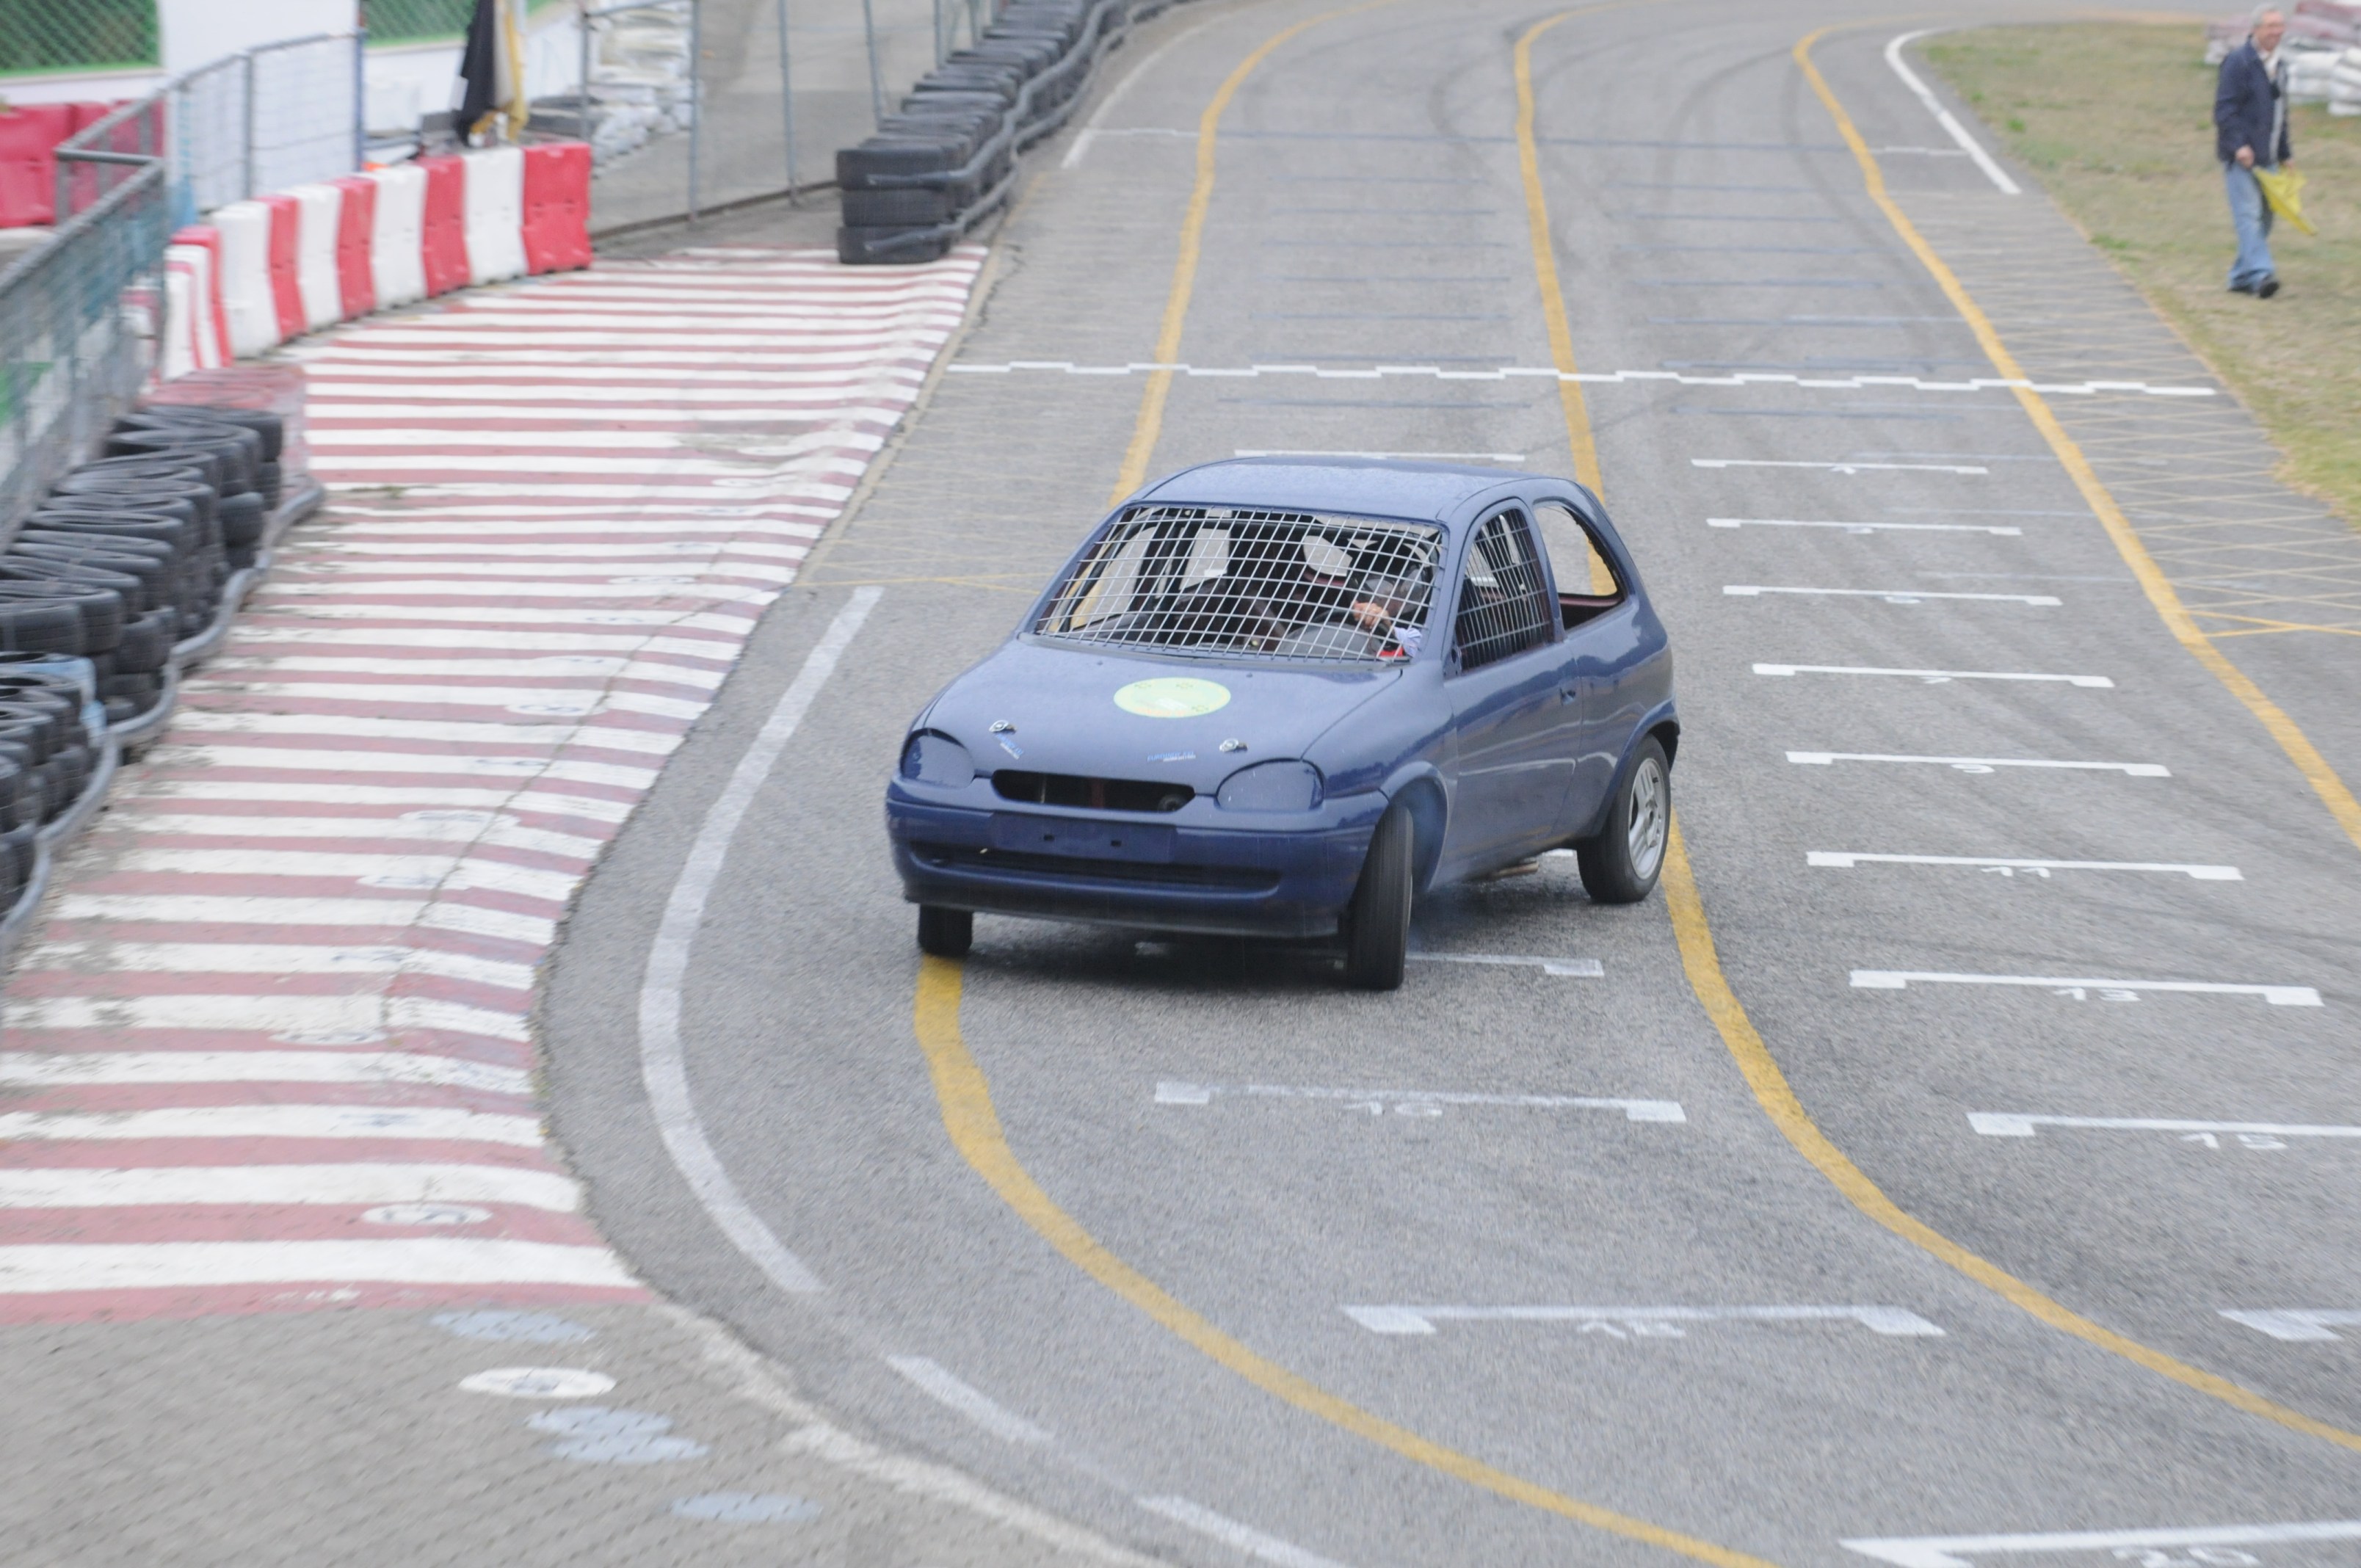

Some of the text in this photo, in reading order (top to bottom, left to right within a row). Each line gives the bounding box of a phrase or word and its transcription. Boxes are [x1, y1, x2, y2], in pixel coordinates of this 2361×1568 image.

[1920, 676, 1952, 684] 7
[1951, 763, 1995, 774] 9
[1981, 866, 2050, 878] 11
[2053, 987, 2141, 1001] 13
[2179, 1132, 2288, 1150] 15
